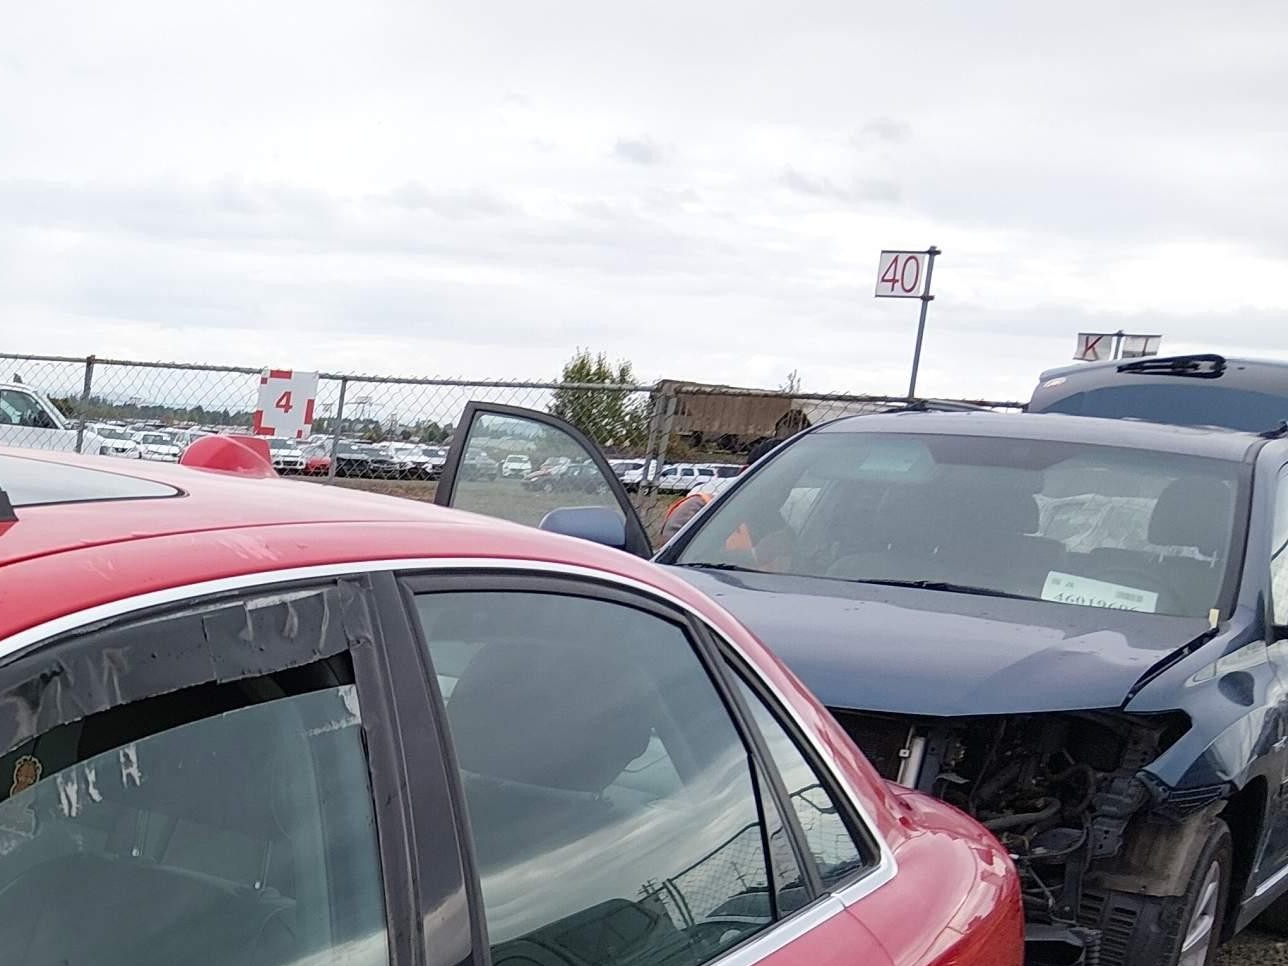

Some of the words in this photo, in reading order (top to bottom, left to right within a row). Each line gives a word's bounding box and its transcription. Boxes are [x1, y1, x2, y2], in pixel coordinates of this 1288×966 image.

[880, 254, 920, 293] 40
[1081, 335, 1105, 361] K
[275, 391, 293, 414] 4
